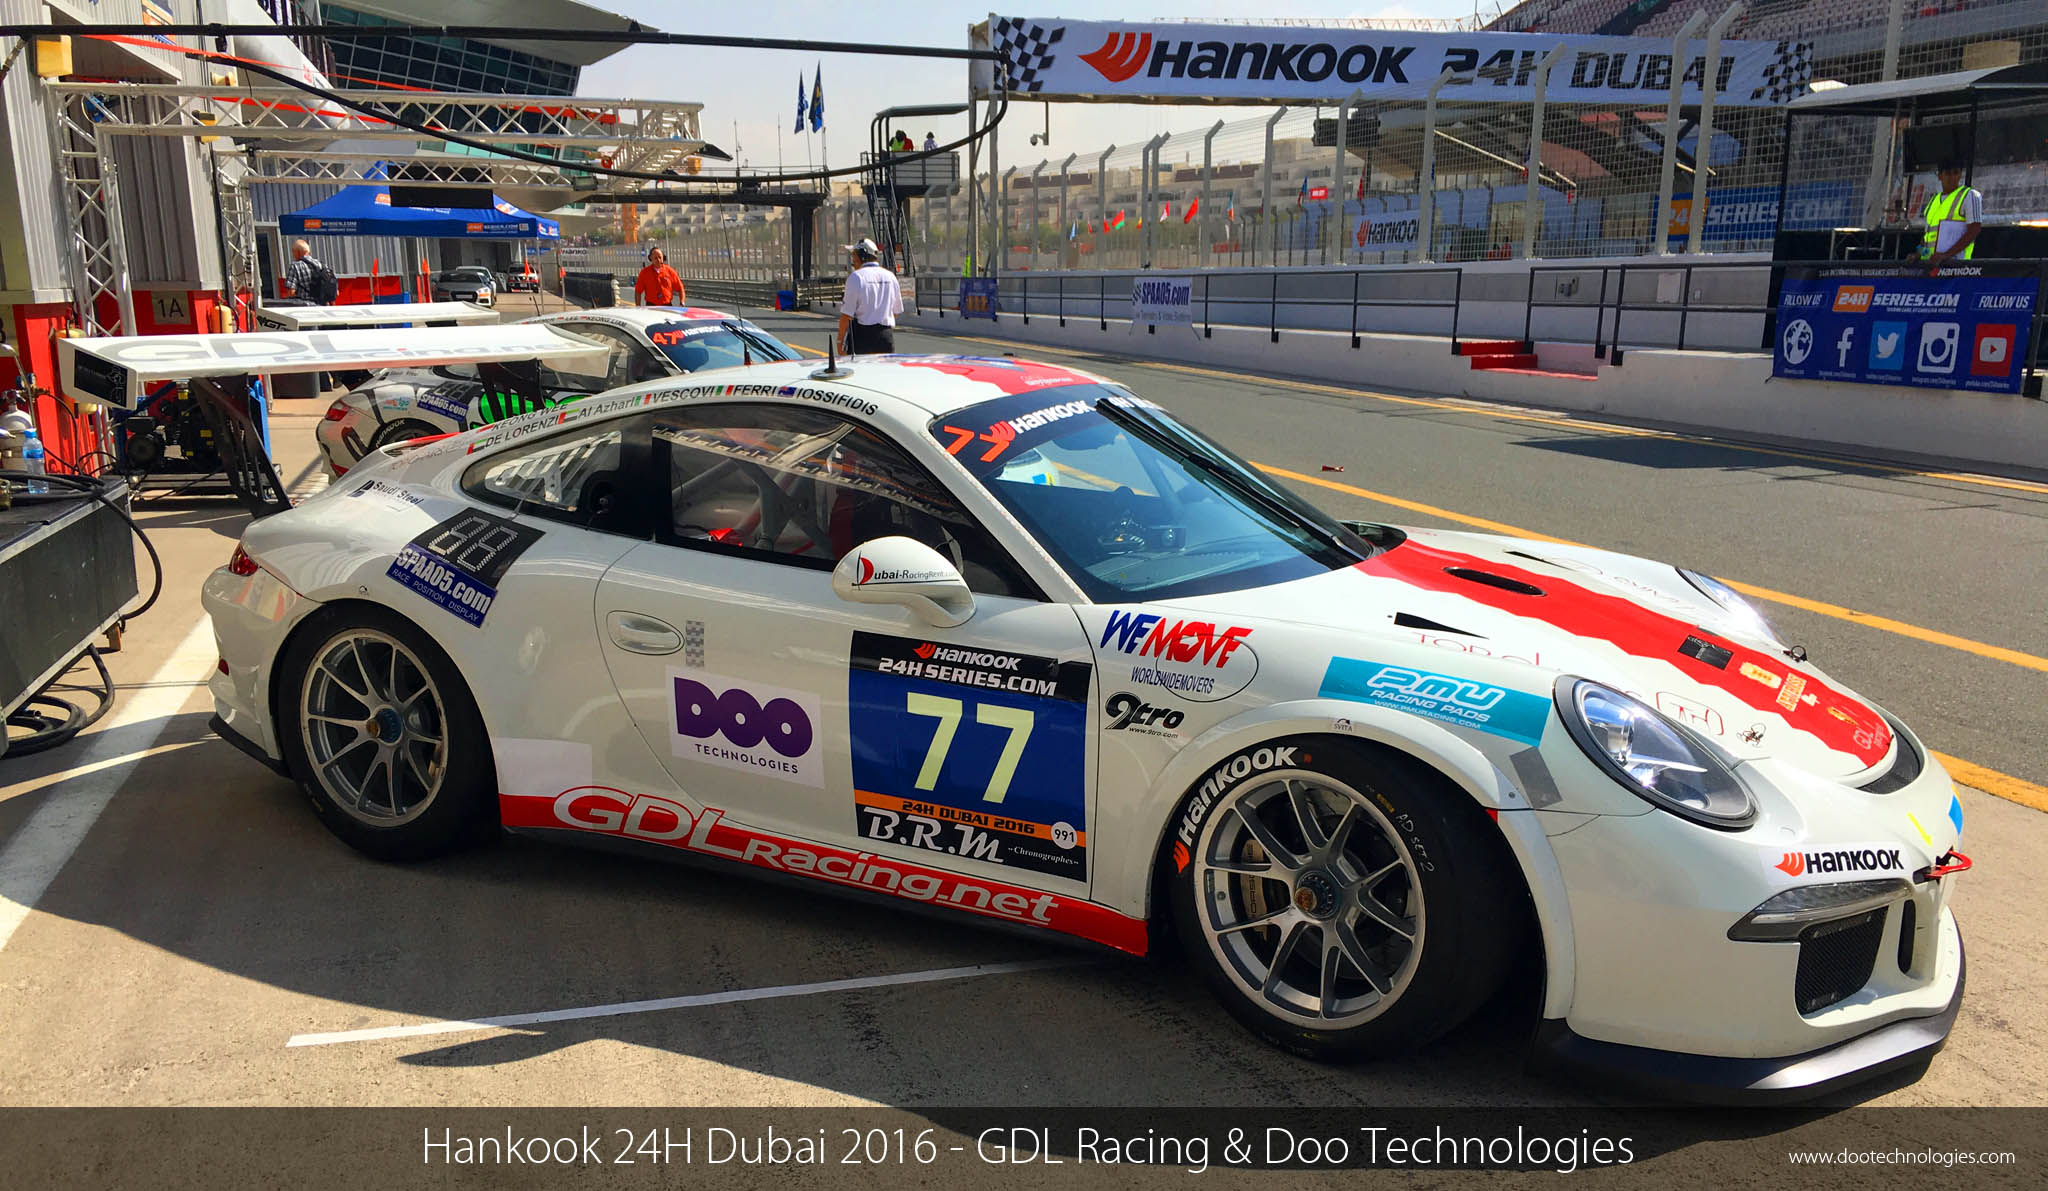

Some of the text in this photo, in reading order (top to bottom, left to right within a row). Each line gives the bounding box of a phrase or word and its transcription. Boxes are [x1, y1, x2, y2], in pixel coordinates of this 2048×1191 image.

[1442, 48, 1554, 87] 24H
[1569, 51, 1735, 92] DUBAI
[158, 298, 185, 319] 1A
[1142, 281, 1190, 305] SPAA05.com
[1838, 292, 1961, 307] 24H SERIES.COM
[1978, 295, 2030, 309] FOLLOW US
[652, 331, 679, 345] 47
[420, 393, 467, 417] SPAA05.com
[653, 384, 879, 416] VESCOVI FERRI IOSSIFIDIS
[485, 432, 501, 449] DE
[505, 414, 559, 441] LORENZI
[372, 481, 424, 505] Saudi Steel
[392, 568, 479, 622] RACE POSITION DISPLAY
[396, 548, 492, 615] SPAA05.com
[878, 656, 1059, 697] 24H SERIES.COM
[1131, 666, 1215, 694] WORLDWIDEMOVERS
[674, 677, 813, 758] DOO
[1104, 691, 1185, 730] 9tro
[1369, 689, 1492, 723] RACING PADS
[695, 743, 799, 775] TECHNOLOGIES
[906, 691, 1035, 804] 77
[902, 800, 1035, 835] 24H DUBAI 2016
[1054, 828, 1076, 843] 991
